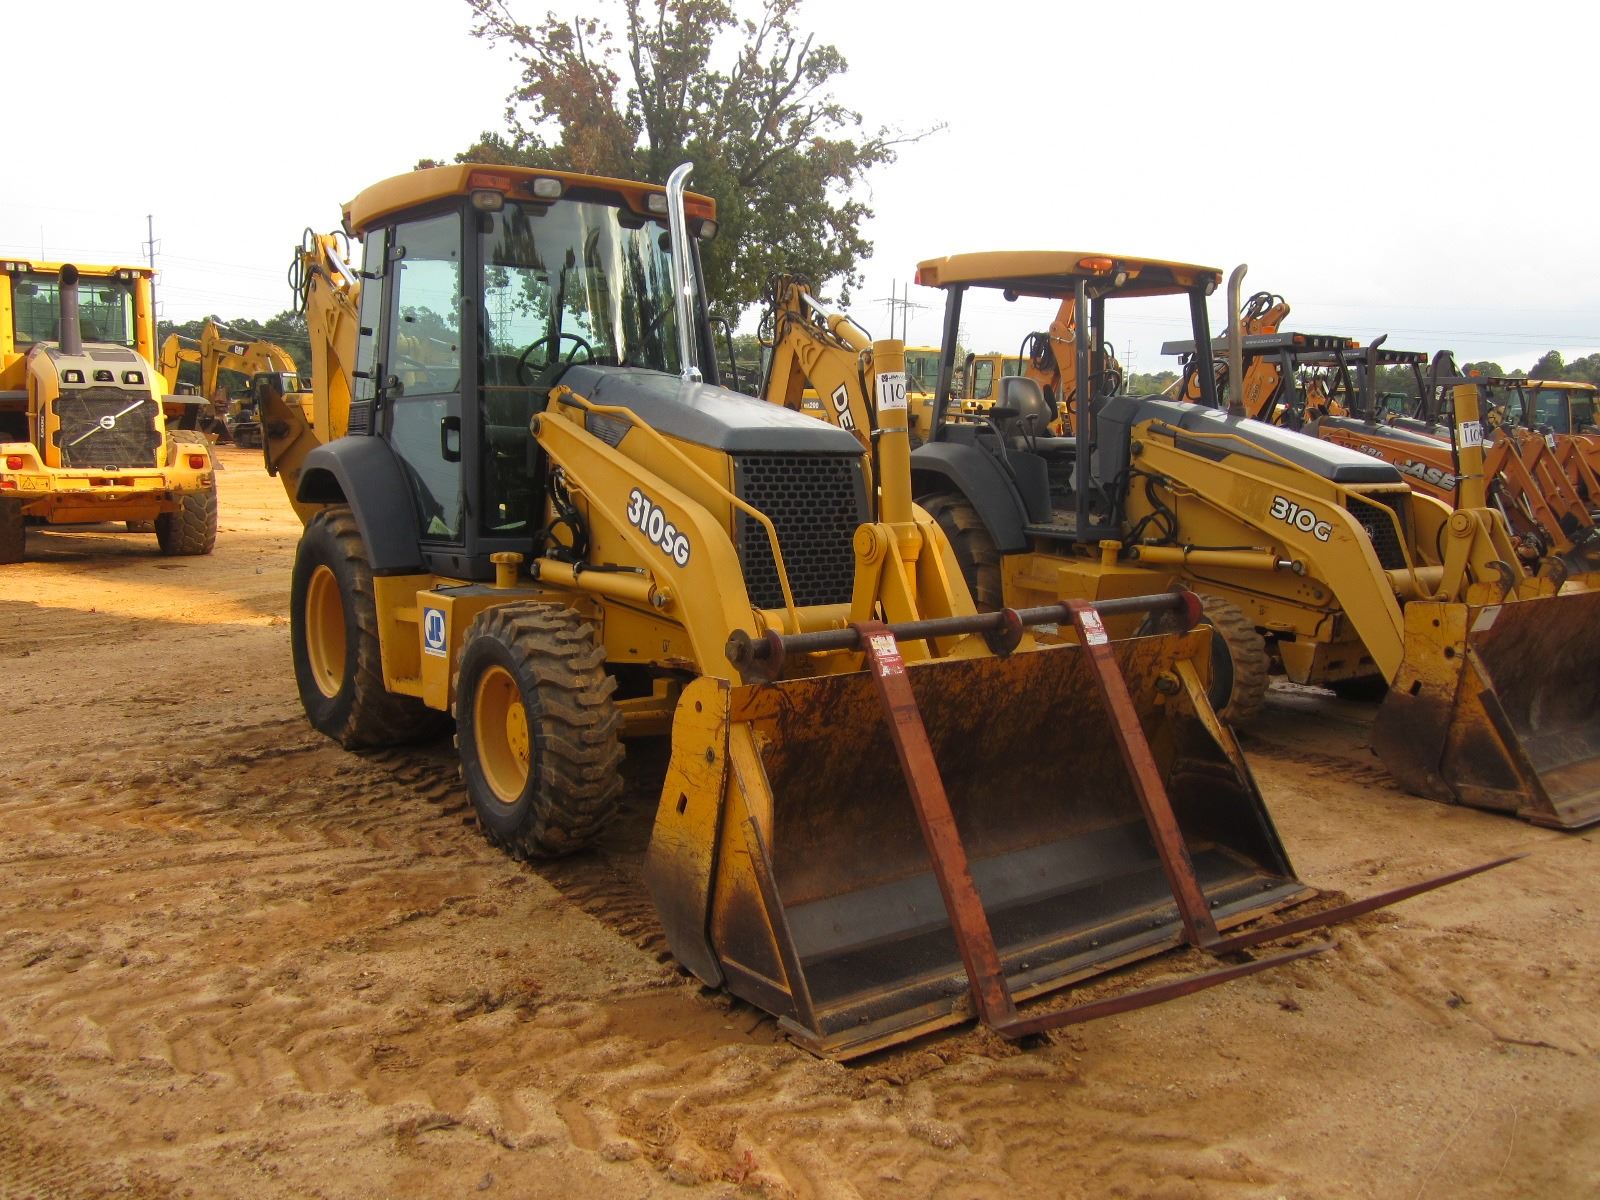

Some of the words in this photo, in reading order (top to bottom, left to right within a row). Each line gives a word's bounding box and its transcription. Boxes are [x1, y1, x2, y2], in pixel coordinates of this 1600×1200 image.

[882, 383, 905, 404] 110
[1393, 458, 1457, 492] CASE
[627, 487, 690, 568] 310SG
[1269, 495, 1333, 542] 310G
